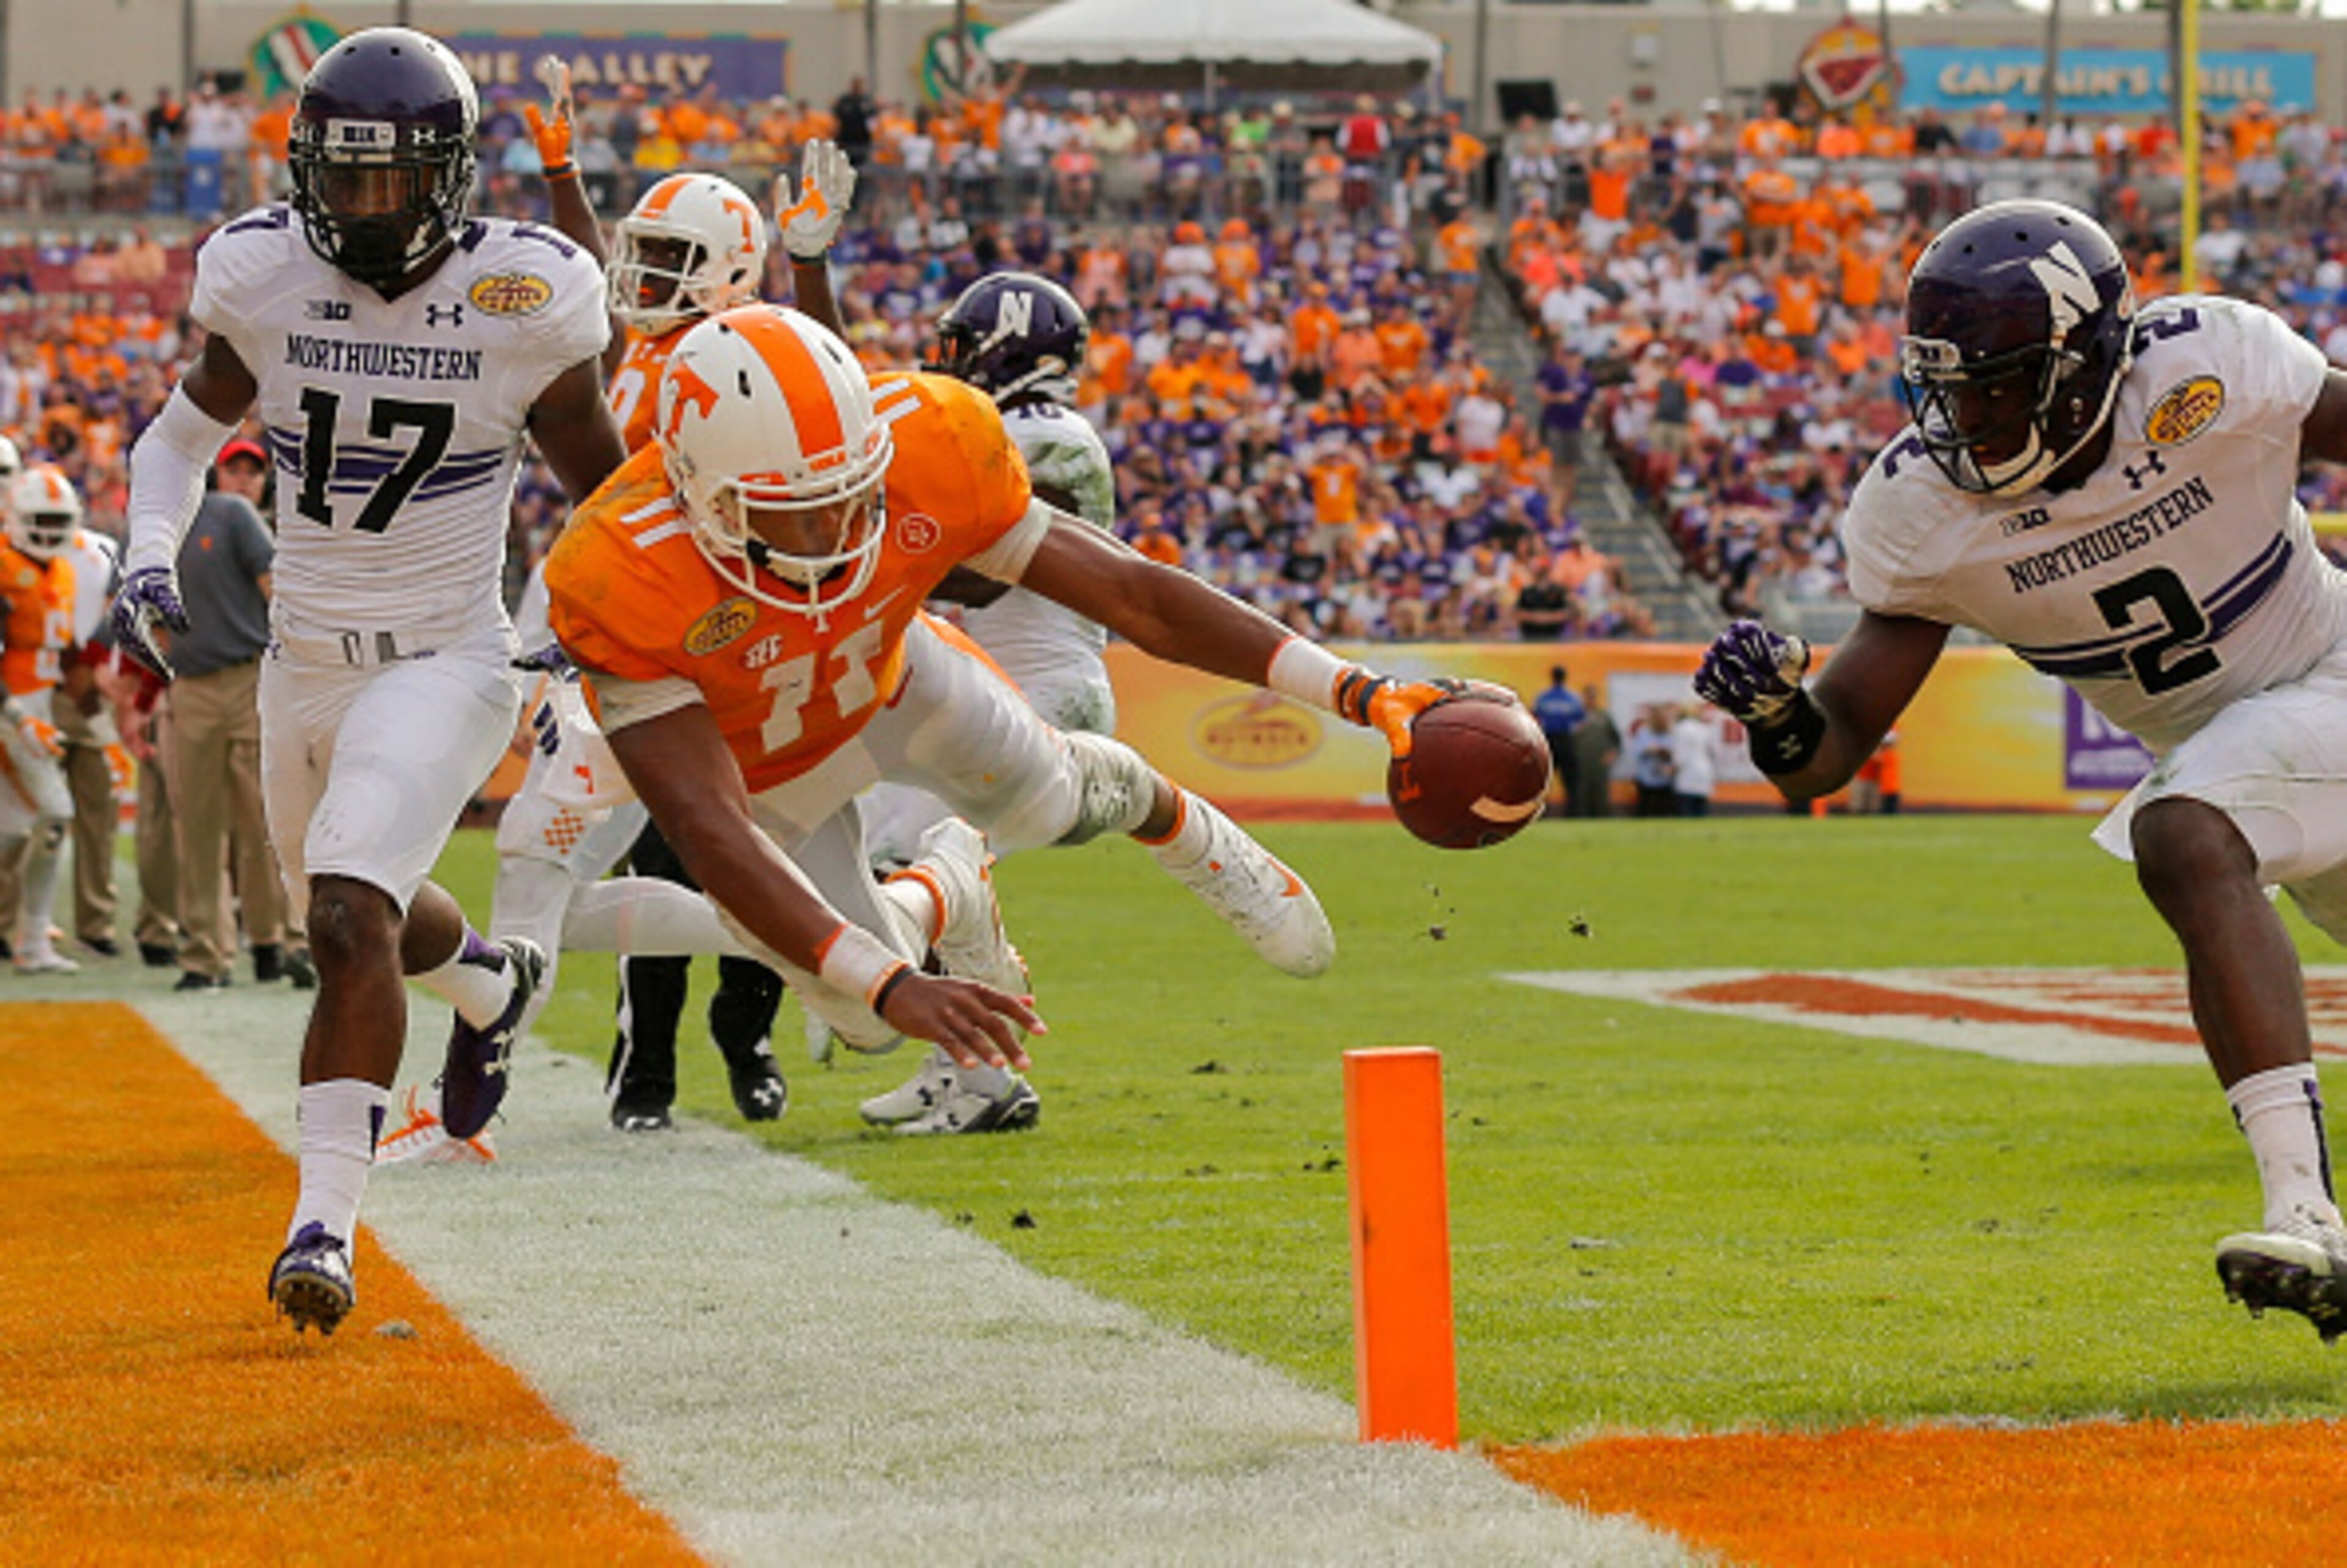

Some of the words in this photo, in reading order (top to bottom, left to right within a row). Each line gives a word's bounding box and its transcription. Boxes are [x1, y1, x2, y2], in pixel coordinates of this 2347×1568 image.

[722, 197, 755, 254] T
[997, 291, 1033, 337] N
[2030, 241, 2101, 331] N
[285, 334, 482, 381] NORTHWESTERN
[296, 386, 455, 533] 17
[2005, 477, 2215, 594] NORTHWESTERN
[2091, 567, 2222, 695] 2
[758, 618, 884, 755] 11
